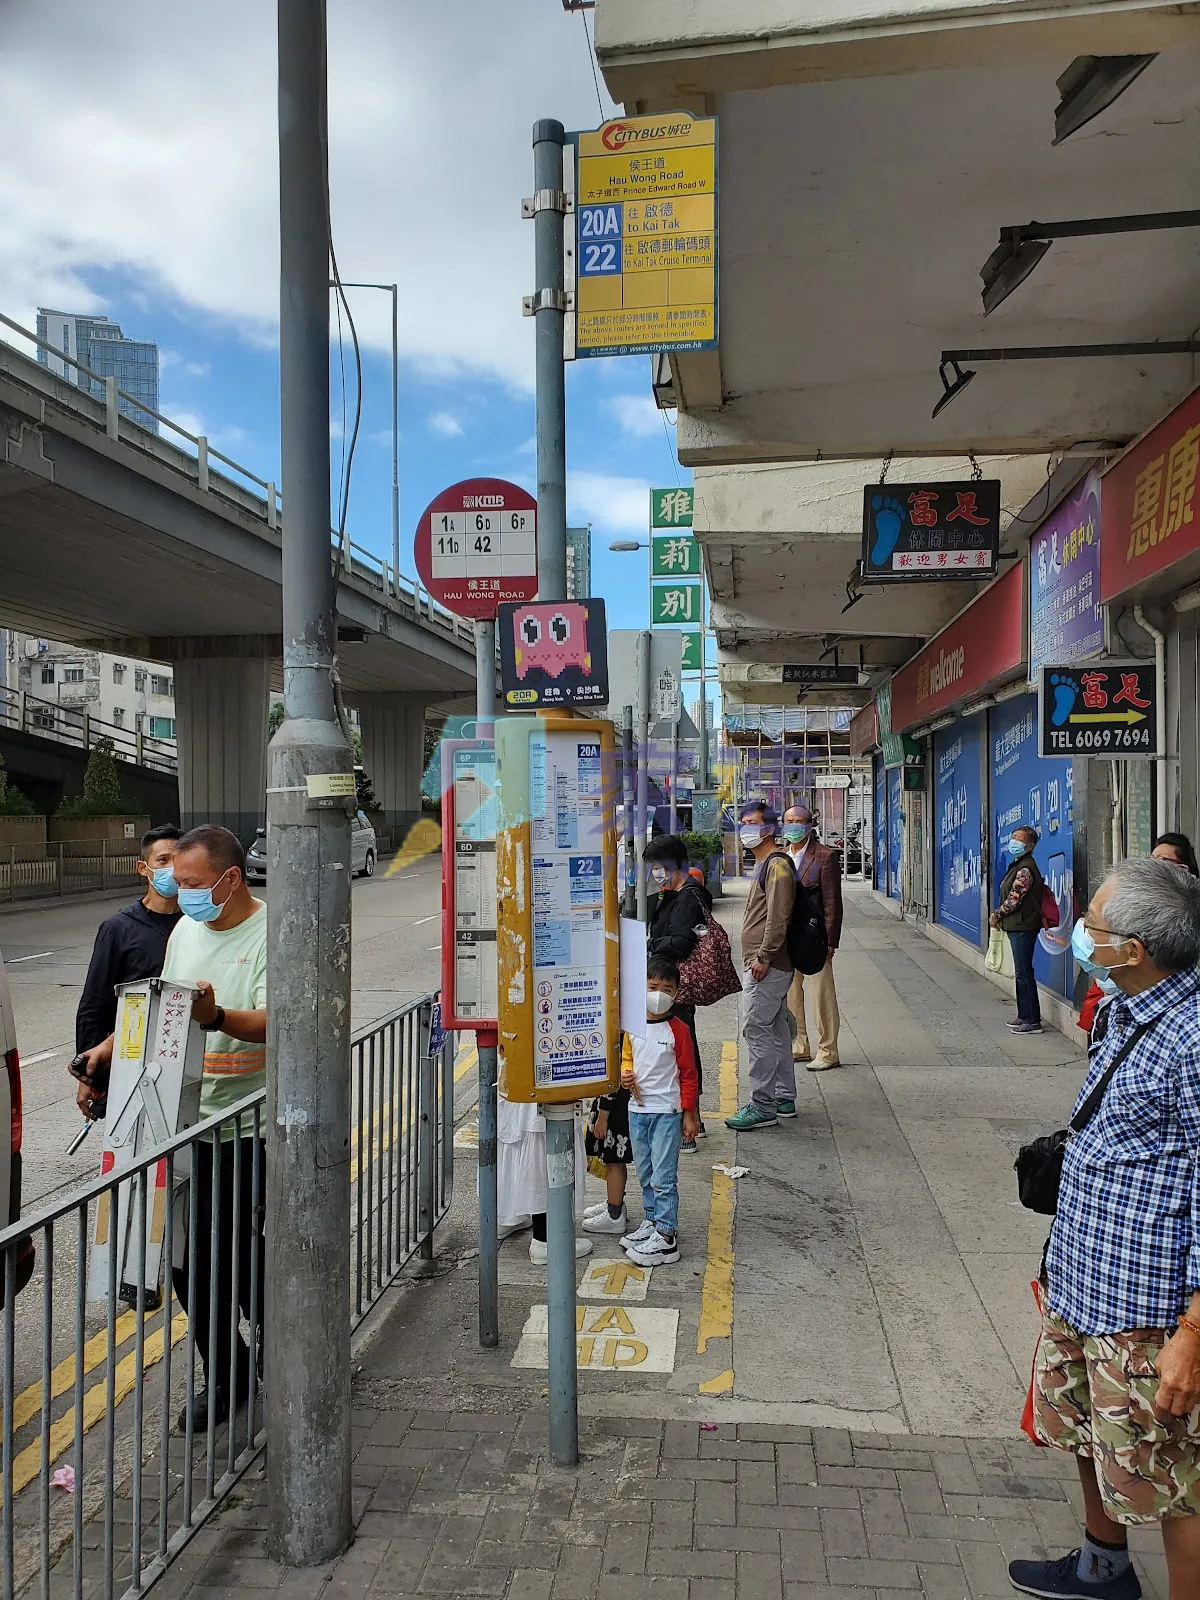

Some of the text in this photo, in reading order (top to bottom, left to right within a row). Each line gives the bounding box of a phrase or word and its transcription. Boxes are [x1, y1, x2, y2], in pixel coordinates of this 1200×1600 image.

[614, 126, 667, 142] CITYBUS
[667, 124, 692, 136] 城巴
[629, 157, 665, 172] 侯王道
[609, 170, 684, 185] Hau Wong Road
[588, 188, 620, 198] 太子道西
[624, 186, 646, 194] Prince
[648, 183, 676, 192] Edward
[678, 181, 696, 190] Road
[628, 208, 638, 219] 往
[582, 207, 619, 236] 20A
[628, 218, 680, 232] to Kai Tak
[624, 244, 634, 256] 往
[585, 244, 616, 272] 22
[624, 252, 712, 268] to Kai Tak Cruise Terminal
[593, 326, 612, 334] above
[648, 322, 668, 330] served
[678, 320, 707, 330] specified
[604, 335, 624, 344] please
[626, 332, 640, 340] refer
[629, 341, 702, 353] www.citybus.com.hk
[1127, 422, 1200, 562] 惠康
[475, 495, 504, 507] KMB
[908, 491, 990, 526] 富足
[441, 513, 525, 532] 1A 6D 6P
[438, 536, 491, 554] 11D 42
[468, 580, 500, 591] 侯王道
[444, 592, 462, 600] HAU
[1081, 672, 1151, 708] 富足
[1050, 729, 1150, 748] TEL 6069 7694
[460, 754, 472, 762] 6P
[580, 746, 598, 757] 20A
[1048, 778, 1058, 814] $20
[1032, 790, 1040, 822] $10
[460, 843, 472, 851] 6D
[577, 859, 594, 874] 22
[461, 932, 473, 940] 42
